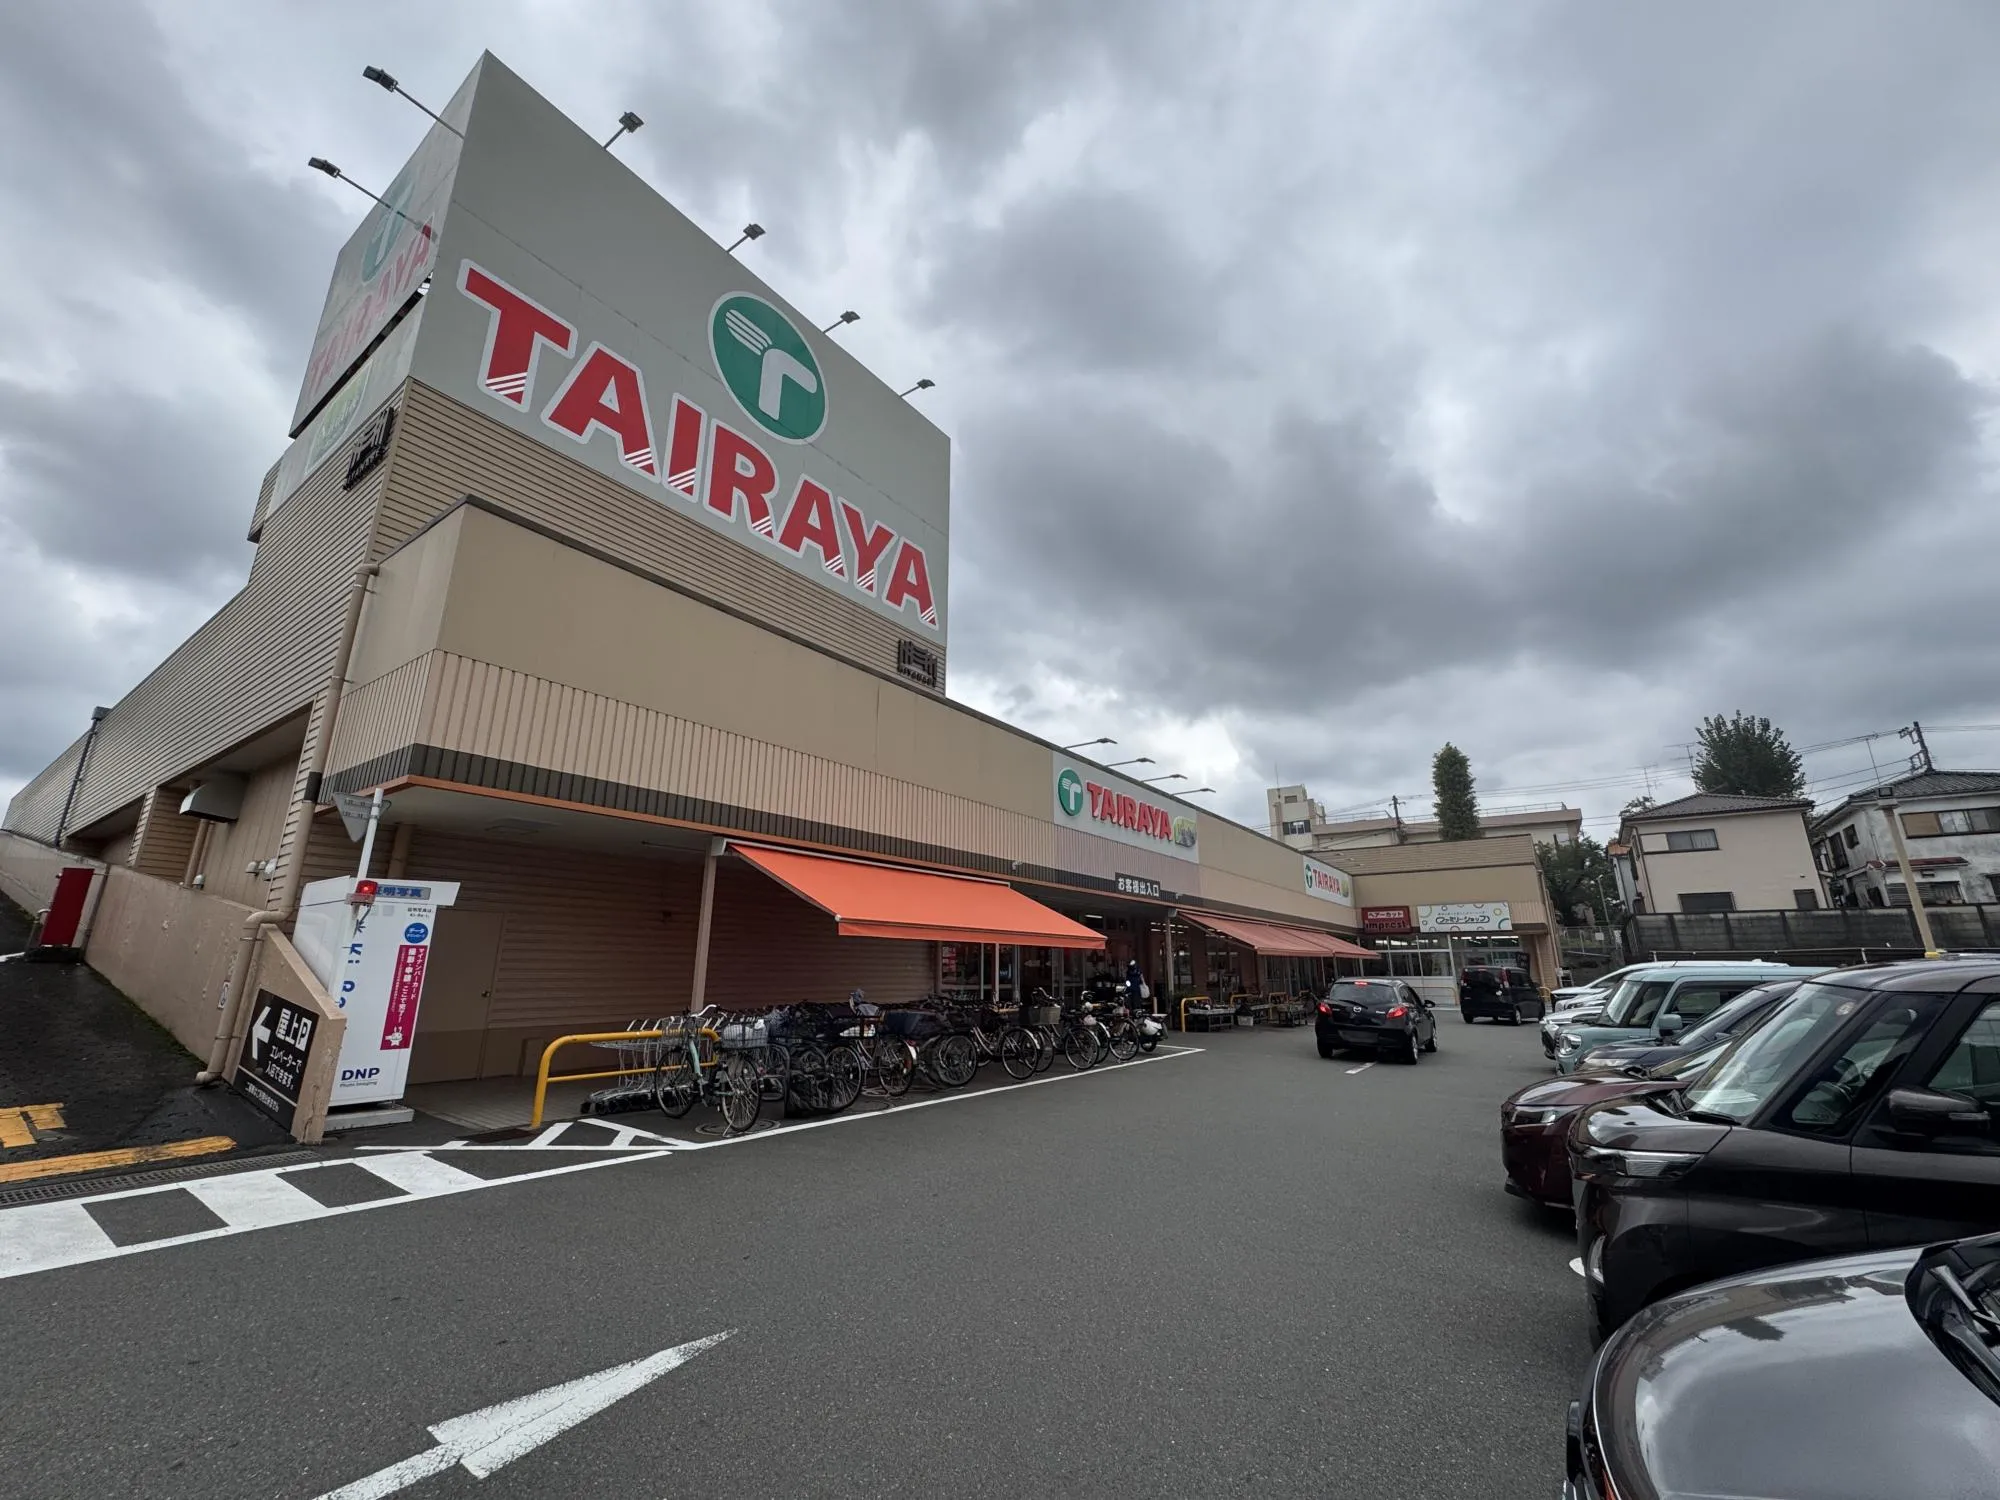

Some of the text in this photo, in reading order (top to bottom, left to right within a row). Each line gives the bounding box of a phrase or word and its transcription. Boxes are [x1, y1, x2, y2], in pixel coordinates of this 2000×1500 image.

[461, 263, 938, 629] TAIRAYA
[1086, 781, 1173, 842] TAIRAYA
[1118, 878, 1160, 897] お客様出入口
[1312, 868, 1341, 896] TAIRAYA
[1436, 914, 1491, 925] ファミリーショップ
[269, 1045, 302, 1074] エレベーターで
[341, 1067, 380, 1081] DNP
